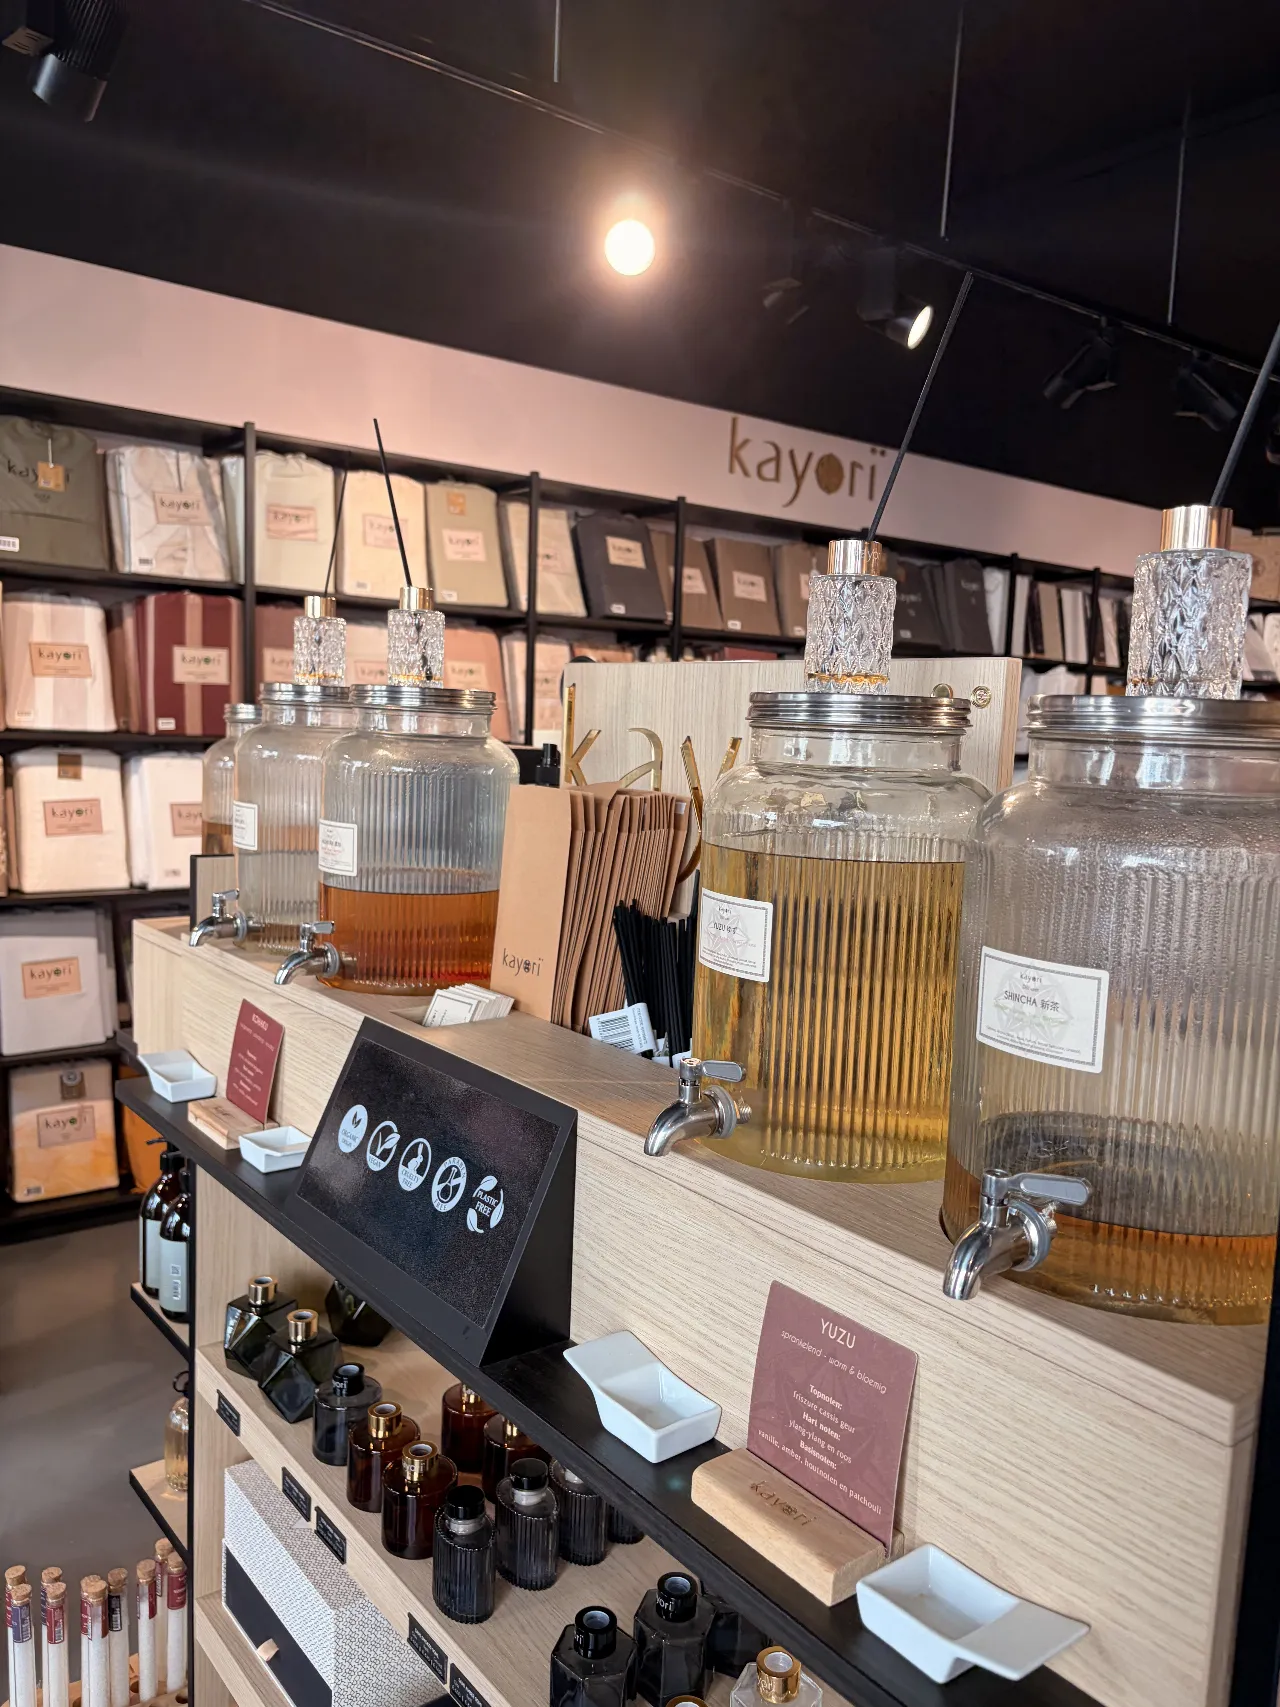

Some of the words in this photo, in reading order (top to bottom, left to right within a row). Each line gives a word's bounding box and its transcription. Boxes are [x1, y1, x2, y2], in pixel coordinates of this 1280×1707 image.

[728, 416, 886, 508] kayorï
[1004, 990, 1038, 1007] SHINCHA
[368, 1155, 381, 1168] VEGAN
[401, 1168, 419, 1183] CRUELTY
[402, 1178, 413, 1189] FREE
[475, 1201, 492, 1217] FREE
[477, 1190, 499, 1208] PLASTIC
[821, 1318, 856, 1349] YUZU
[781, 1330, 823, 1357] sprankelend
[828, 1356, 848, 1372] warm
[849, 1365, 855, 1375] &
[809, 1384, 843, 1410] Topnoten:
[802, 1411, 818, 1427] Hart
[820, 1423, 841, 1441] noten:
[819, 1407, 839, 1424] cassis
[840, 1420, 856, 1434] geur
[788, 1419, 826, 1449] ylang-ylang
[827, 1444, 835, 1454] en
[836, 1449, 852, 1464] roos
[800, 1440, 837, 1470] Basisnoten:
[781, 1444, 803, 1464] amber,
[804, 1457, 838, 1486] houtnoten
[839, 1483, 848, 1493] en
[849, 1489, 882, 1515] patchouli
